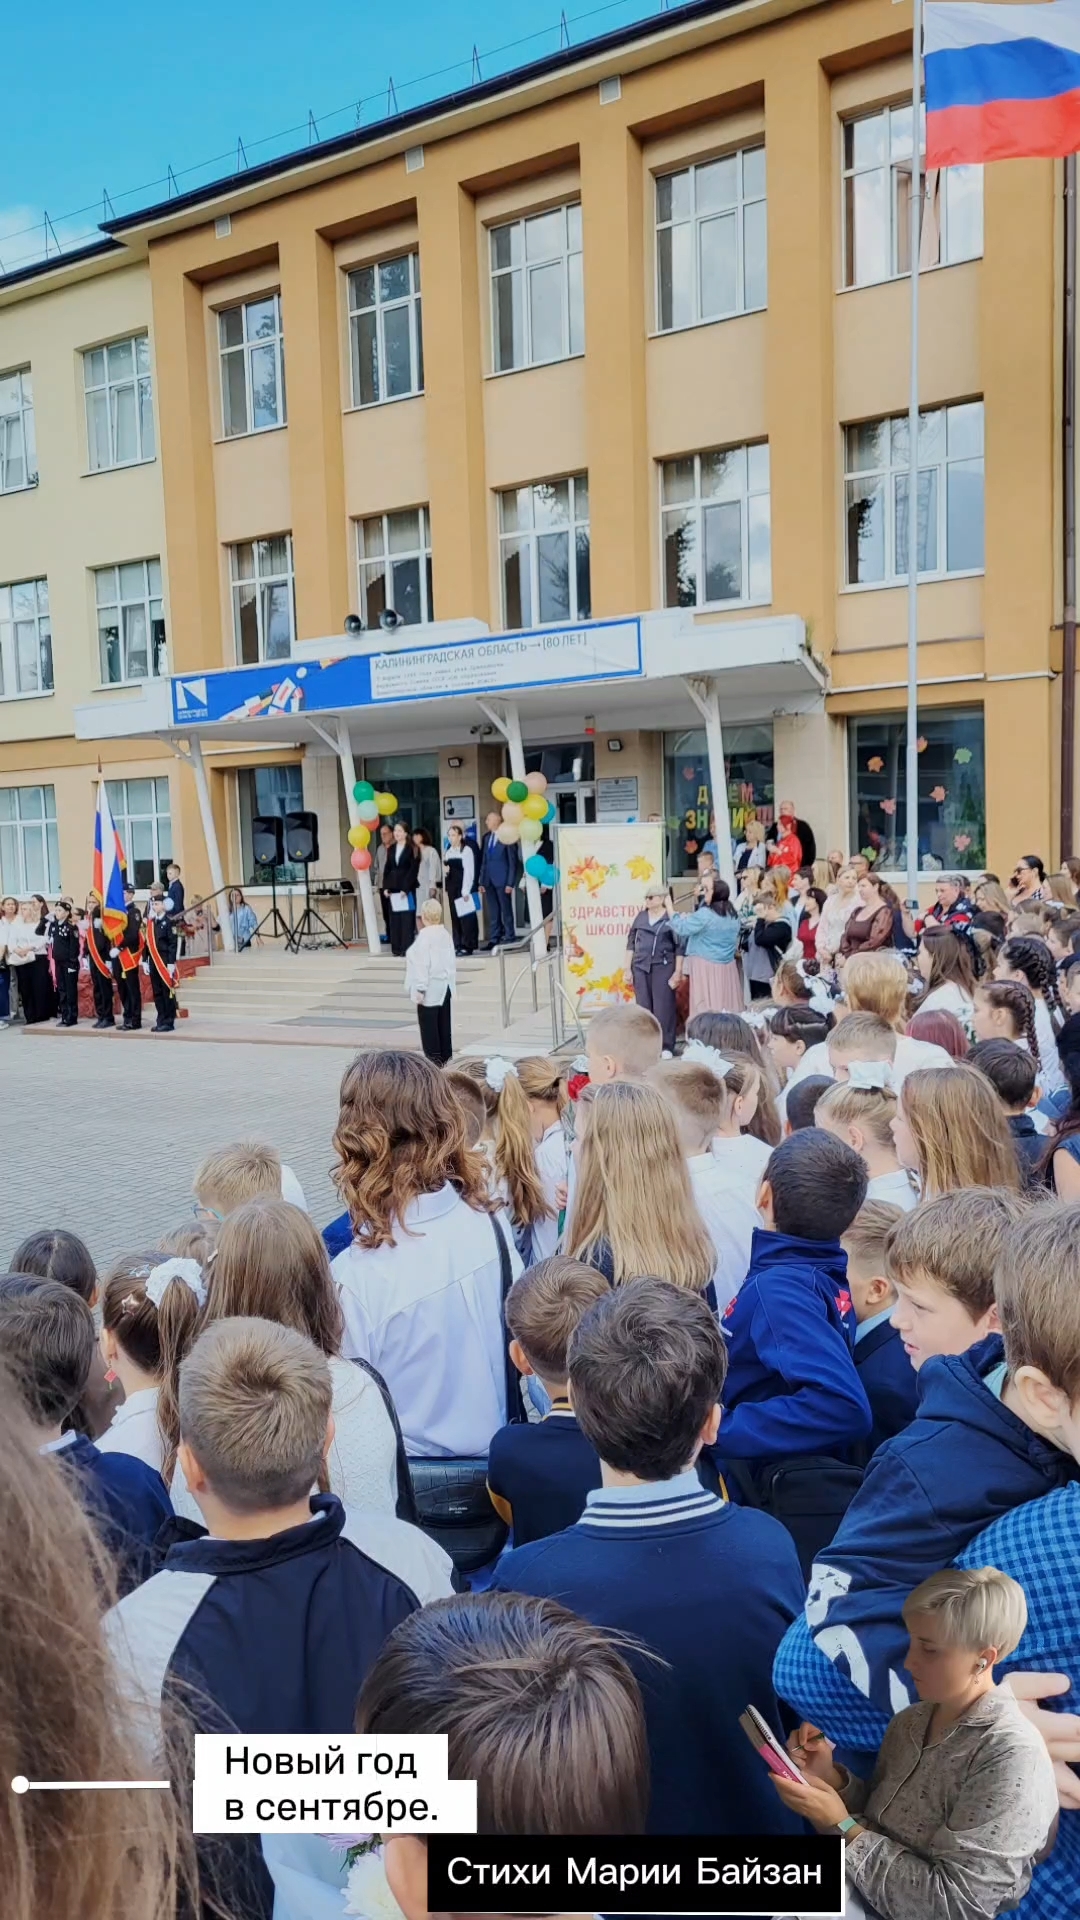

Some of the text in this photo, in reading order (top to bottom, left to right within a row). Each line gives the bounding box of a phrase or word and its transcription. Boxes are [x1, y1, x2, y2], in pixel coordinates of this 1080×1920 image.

[375, 650, 475, 670] КАЛИНИНГРАДСКАЯ
[478, 640, 527, 657] ОБЛАСТЬ
[697, 783, 754, 806] ДЁМ
[569, 905, 644, 920] ЗДРАВСТВУ
